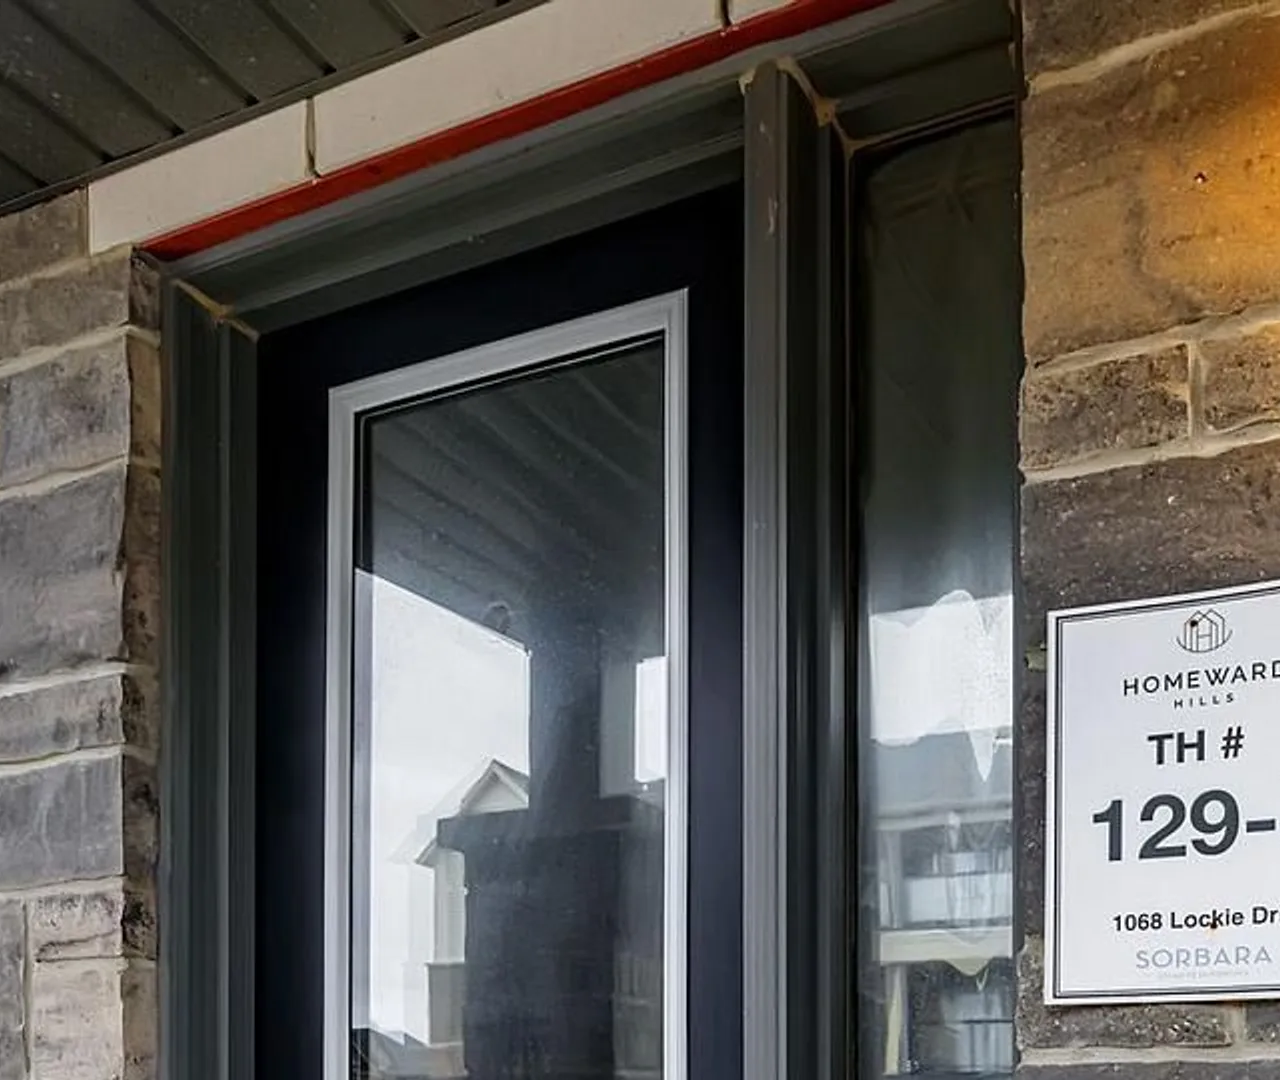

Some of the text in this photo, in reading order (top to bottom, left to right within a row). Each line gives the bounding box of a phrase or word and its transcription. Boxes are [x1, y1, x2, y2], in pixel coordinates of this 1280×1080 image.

[1173, 692, 1235, 709] HILLS
[1147, 726, 1245, 765] TH #
[1113, 911, 1163, 931] 1068
[1171, 909, 1245, 930] Lockie
[1136, 945, 1274, 969] SORBARA
